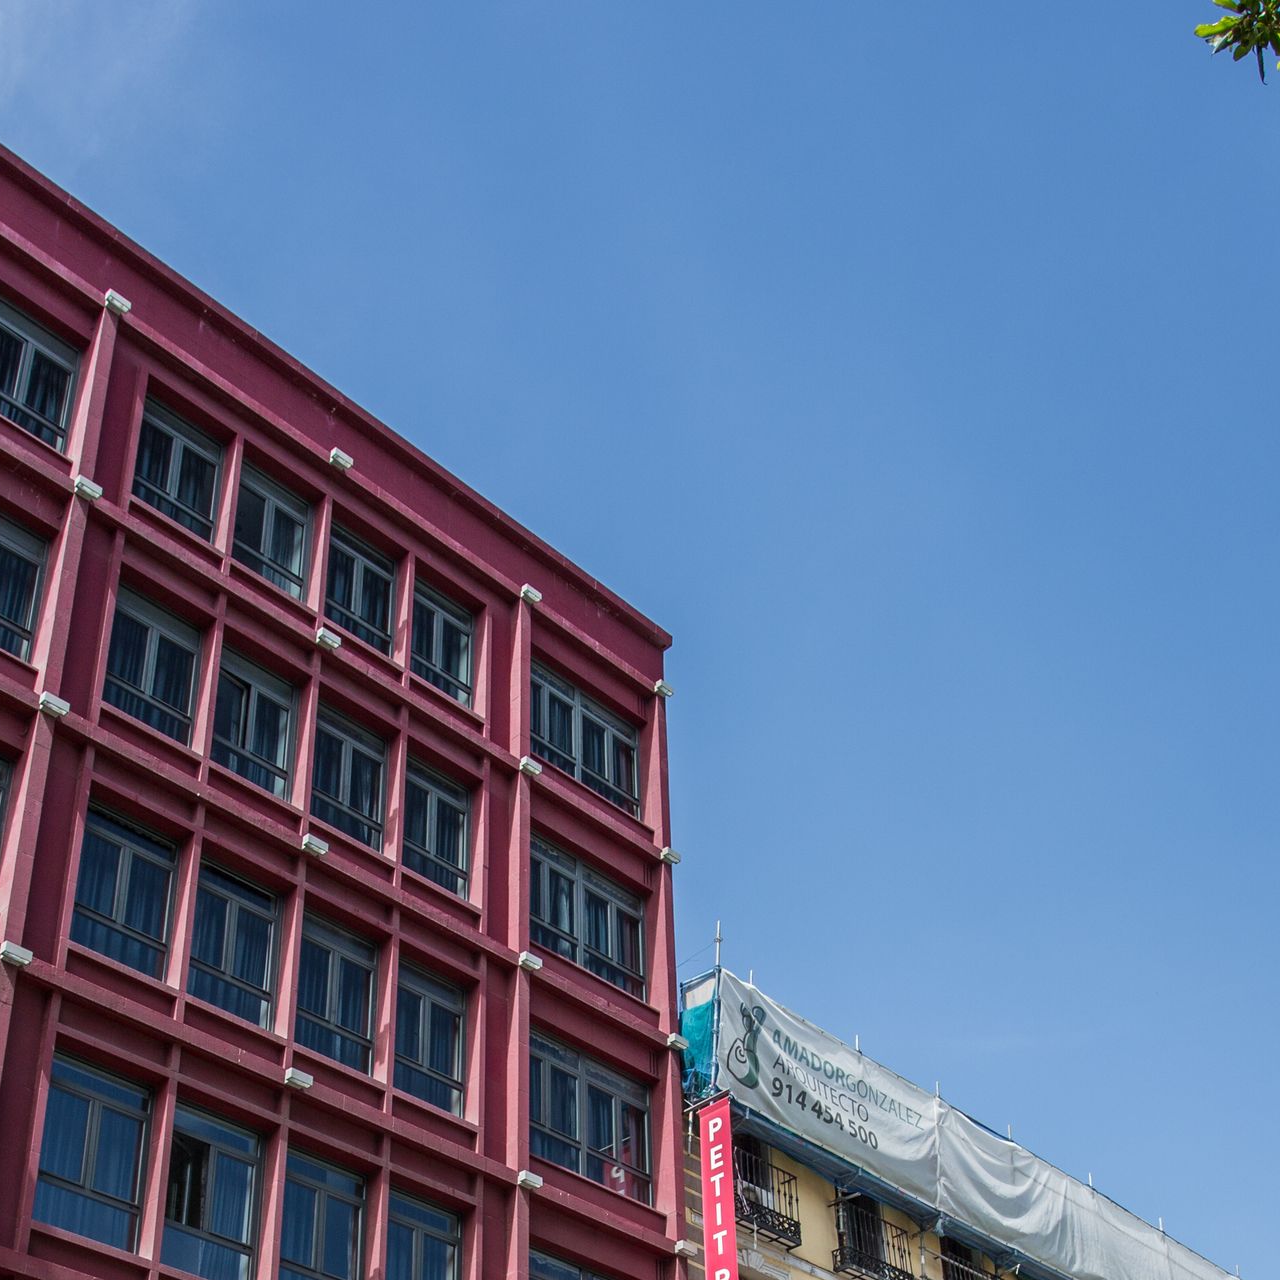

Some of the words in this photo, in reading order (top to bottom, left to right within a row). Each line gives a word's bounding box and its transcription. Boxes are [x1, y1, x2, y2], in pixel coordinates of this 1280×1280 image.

[772, 1077, 807, 1111] 914
[811, 1100, 844, 1132] 454
[849, 1120, 879, 1150] 500
[773, 1053, 869, 1123] ARQUITECTO
[708, 1117, 728, 1255] PETIT
